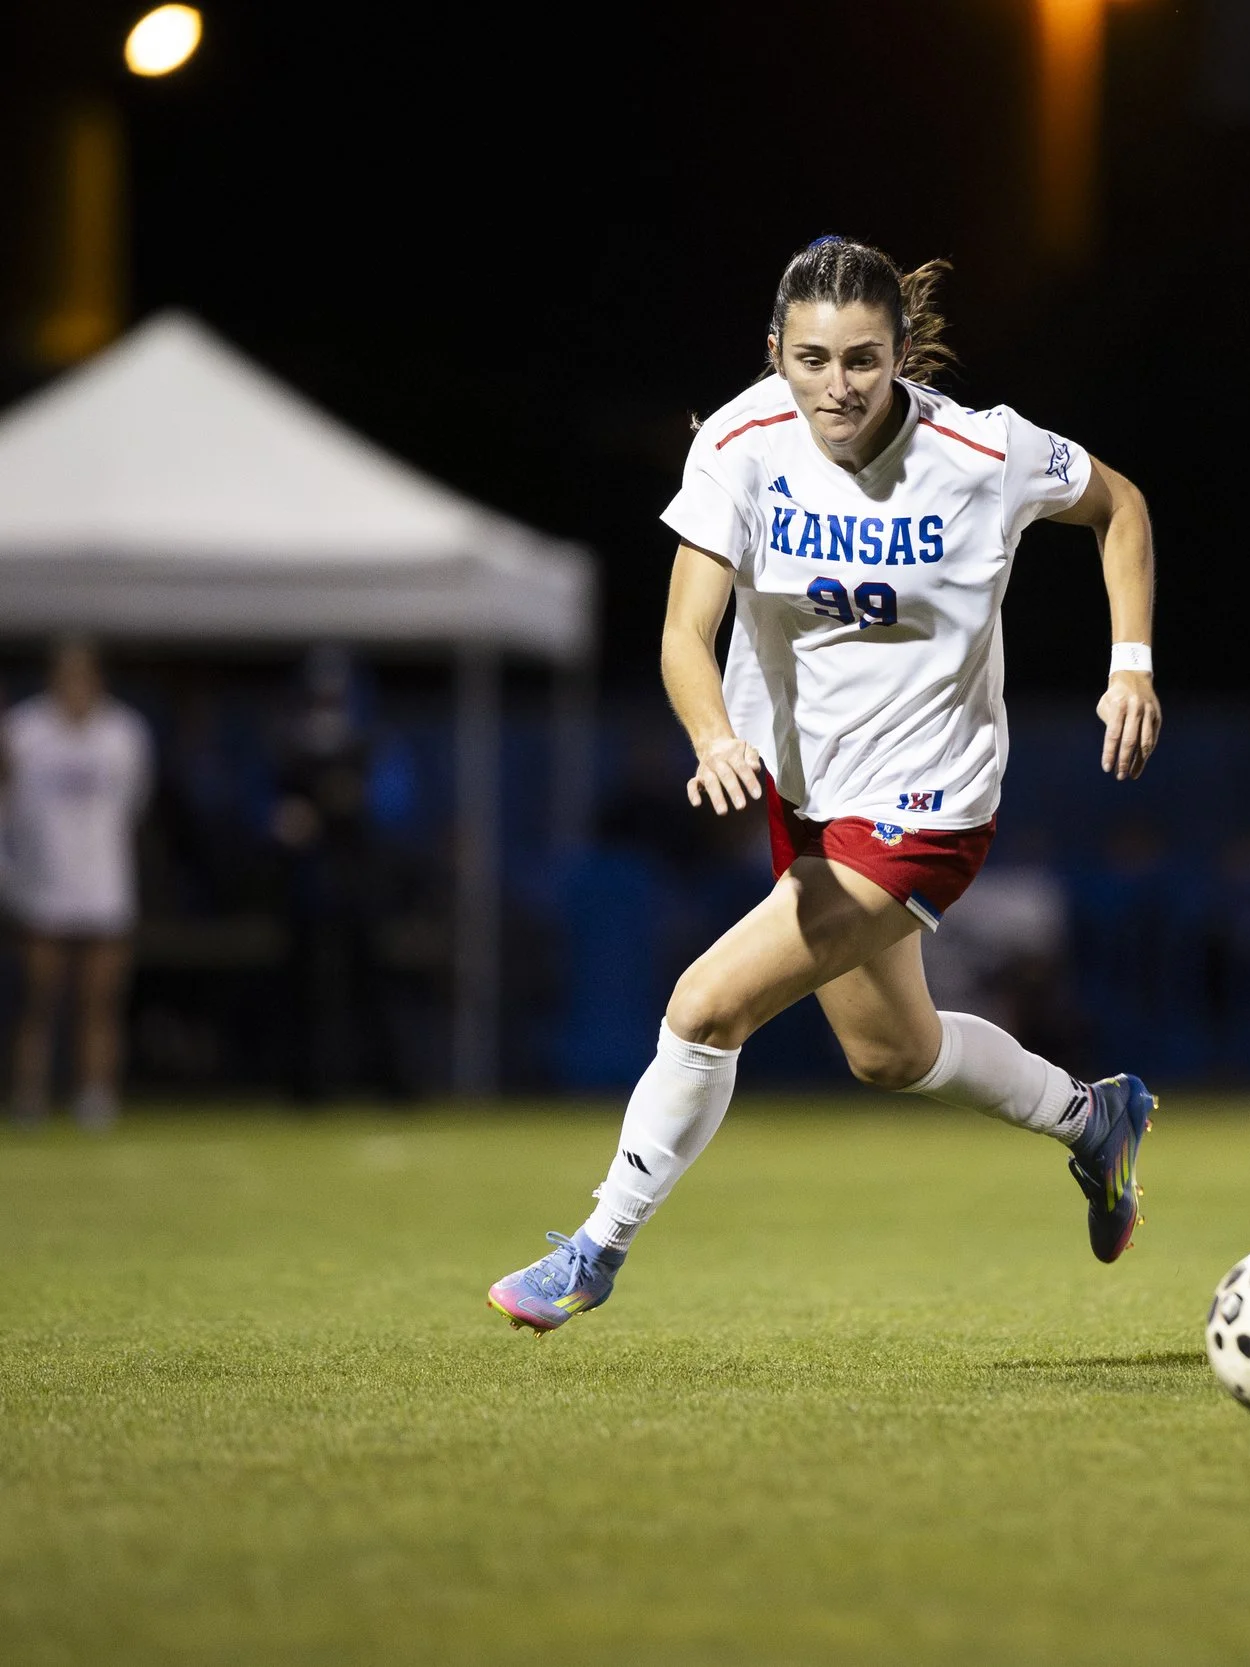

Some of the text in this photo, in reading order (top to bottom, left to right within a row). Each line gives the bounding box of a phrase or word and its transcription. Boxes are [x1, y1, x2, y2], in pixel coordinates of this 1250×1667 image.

[770, 506, 944, 566] KANSAS
[806, 576, 898, 630] 99
[883, 824, 895, 834] KU
